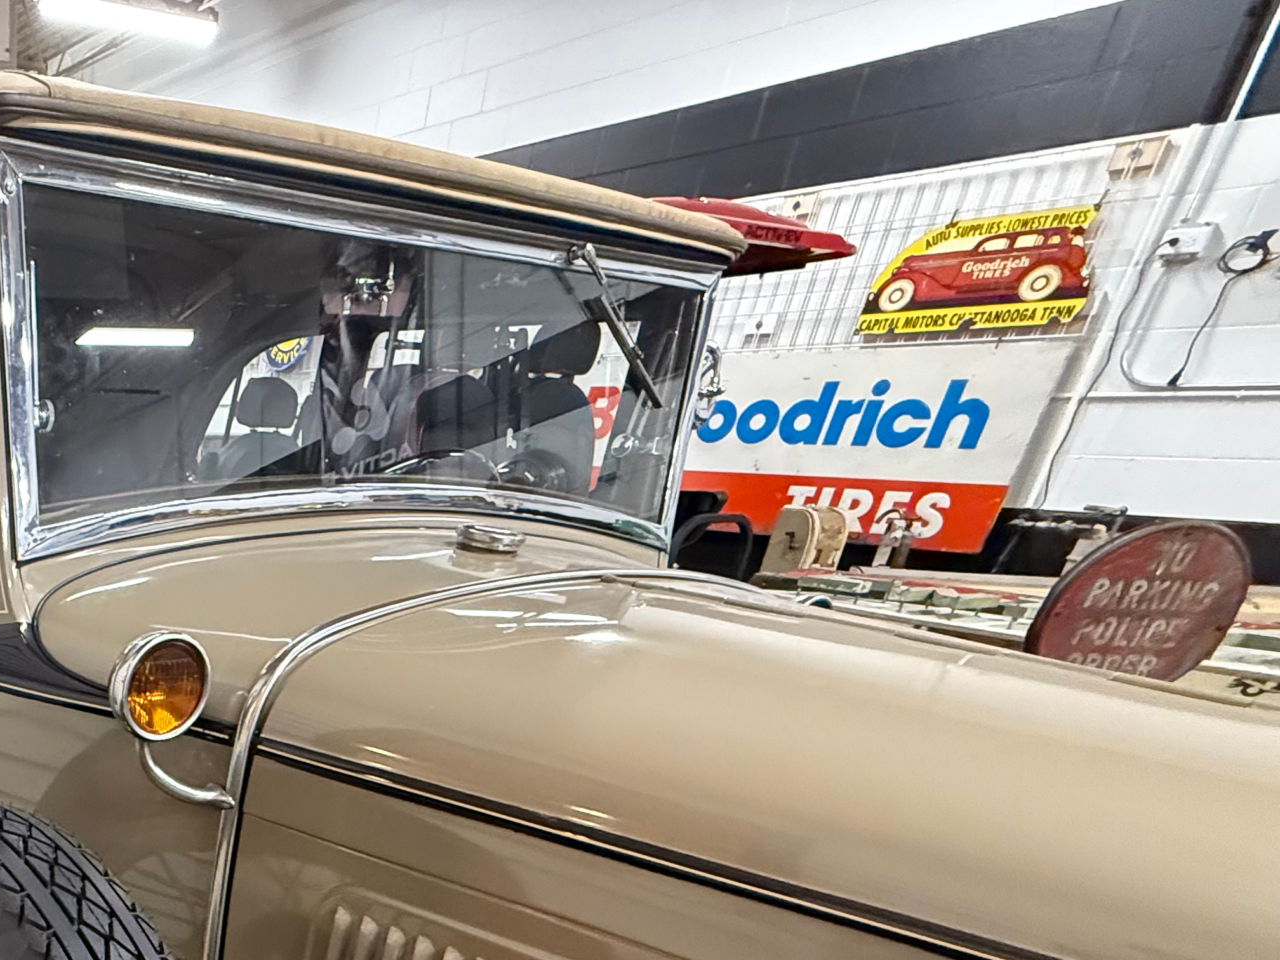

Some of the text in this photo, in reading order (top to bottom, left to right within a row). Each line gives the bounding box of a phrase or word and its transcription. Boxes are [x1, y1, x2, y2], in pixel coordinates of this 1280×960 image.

[925, 229, 951, 251] AUTO
[1050, 210, 1090, 228] PRICES
[961, 256, 1030, 273] Goodrich
[972, 268, 1011, 280] TIRES
[859, 317, 900, 332] CAPITAL
[901, 314, 948, 330] MOTORS
[948, 308, 1038, 327] CHTTANOOGA
[270, 337, 307, 363] ERVIC
[695, 379, 990, 450] oodrich
[1149, 541, 1198, 576] NO
[1083, 577, 1220, 612] PARKING
[1071, 616, 1190, 649] POLICE
